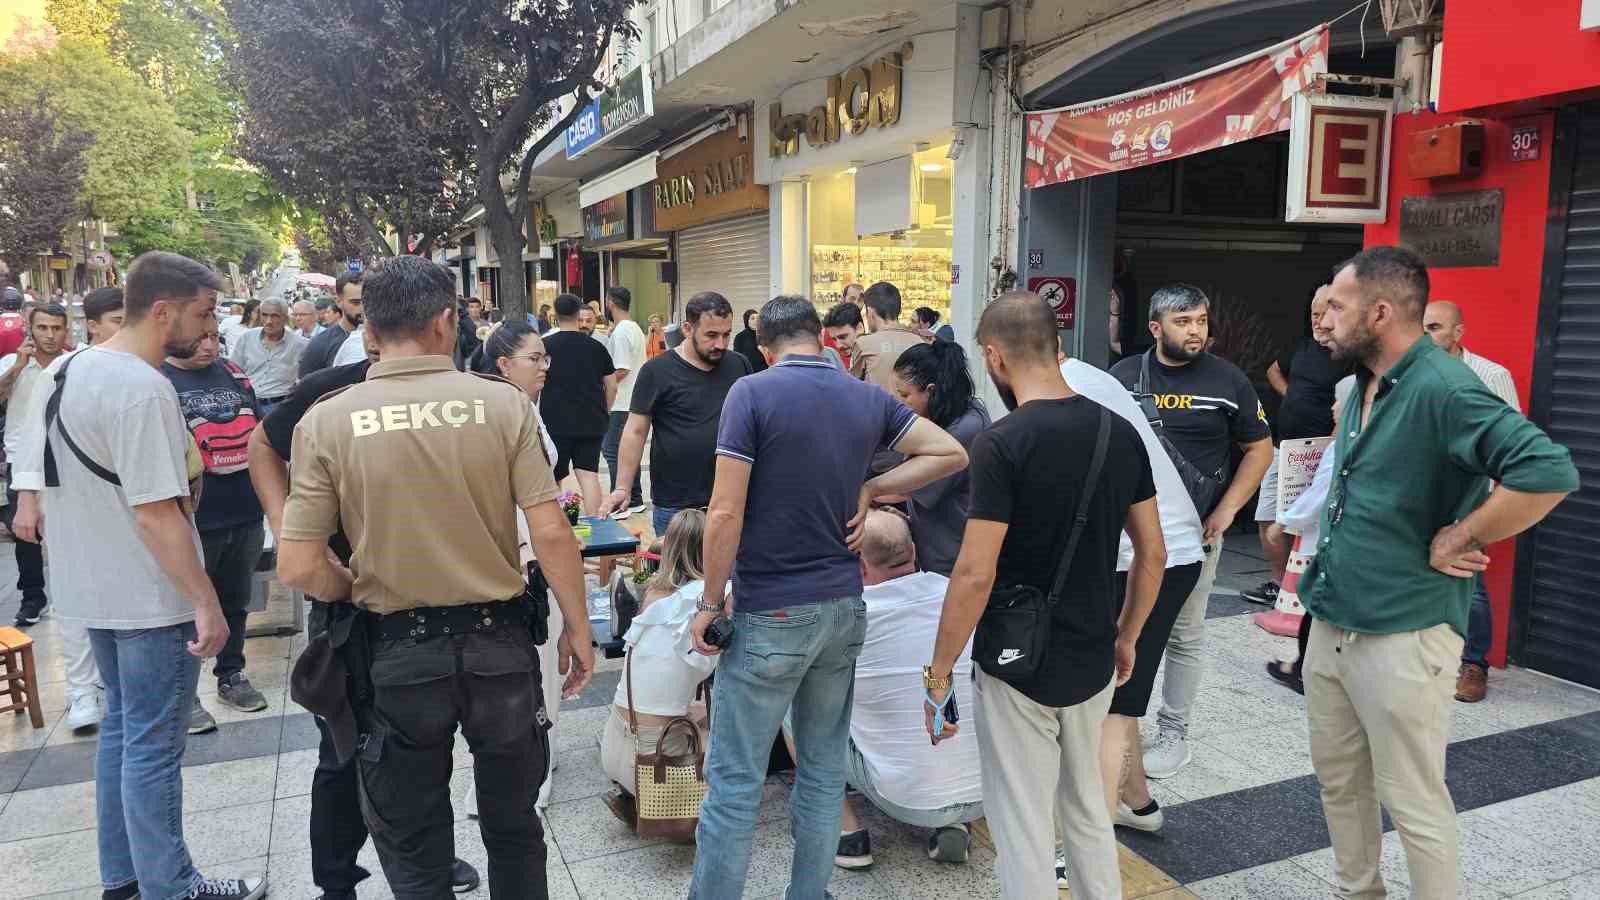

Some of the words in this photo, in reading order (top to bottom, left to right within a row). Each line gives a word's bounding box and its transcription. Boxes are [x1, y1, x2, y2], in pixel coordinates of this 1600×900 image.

[1107, 109, 1133, 129] HOŞ
[1135, 88, 1196, 120] GELDİNİZ
[568, 111, 595, 147] CASIO
[655, 175, 695, 208] BARIŞ
[704, 154, 747, 196] SAAT
[1030, 254, 1042, 264] 30
[1002, 648, 1021, 658] NIKE
